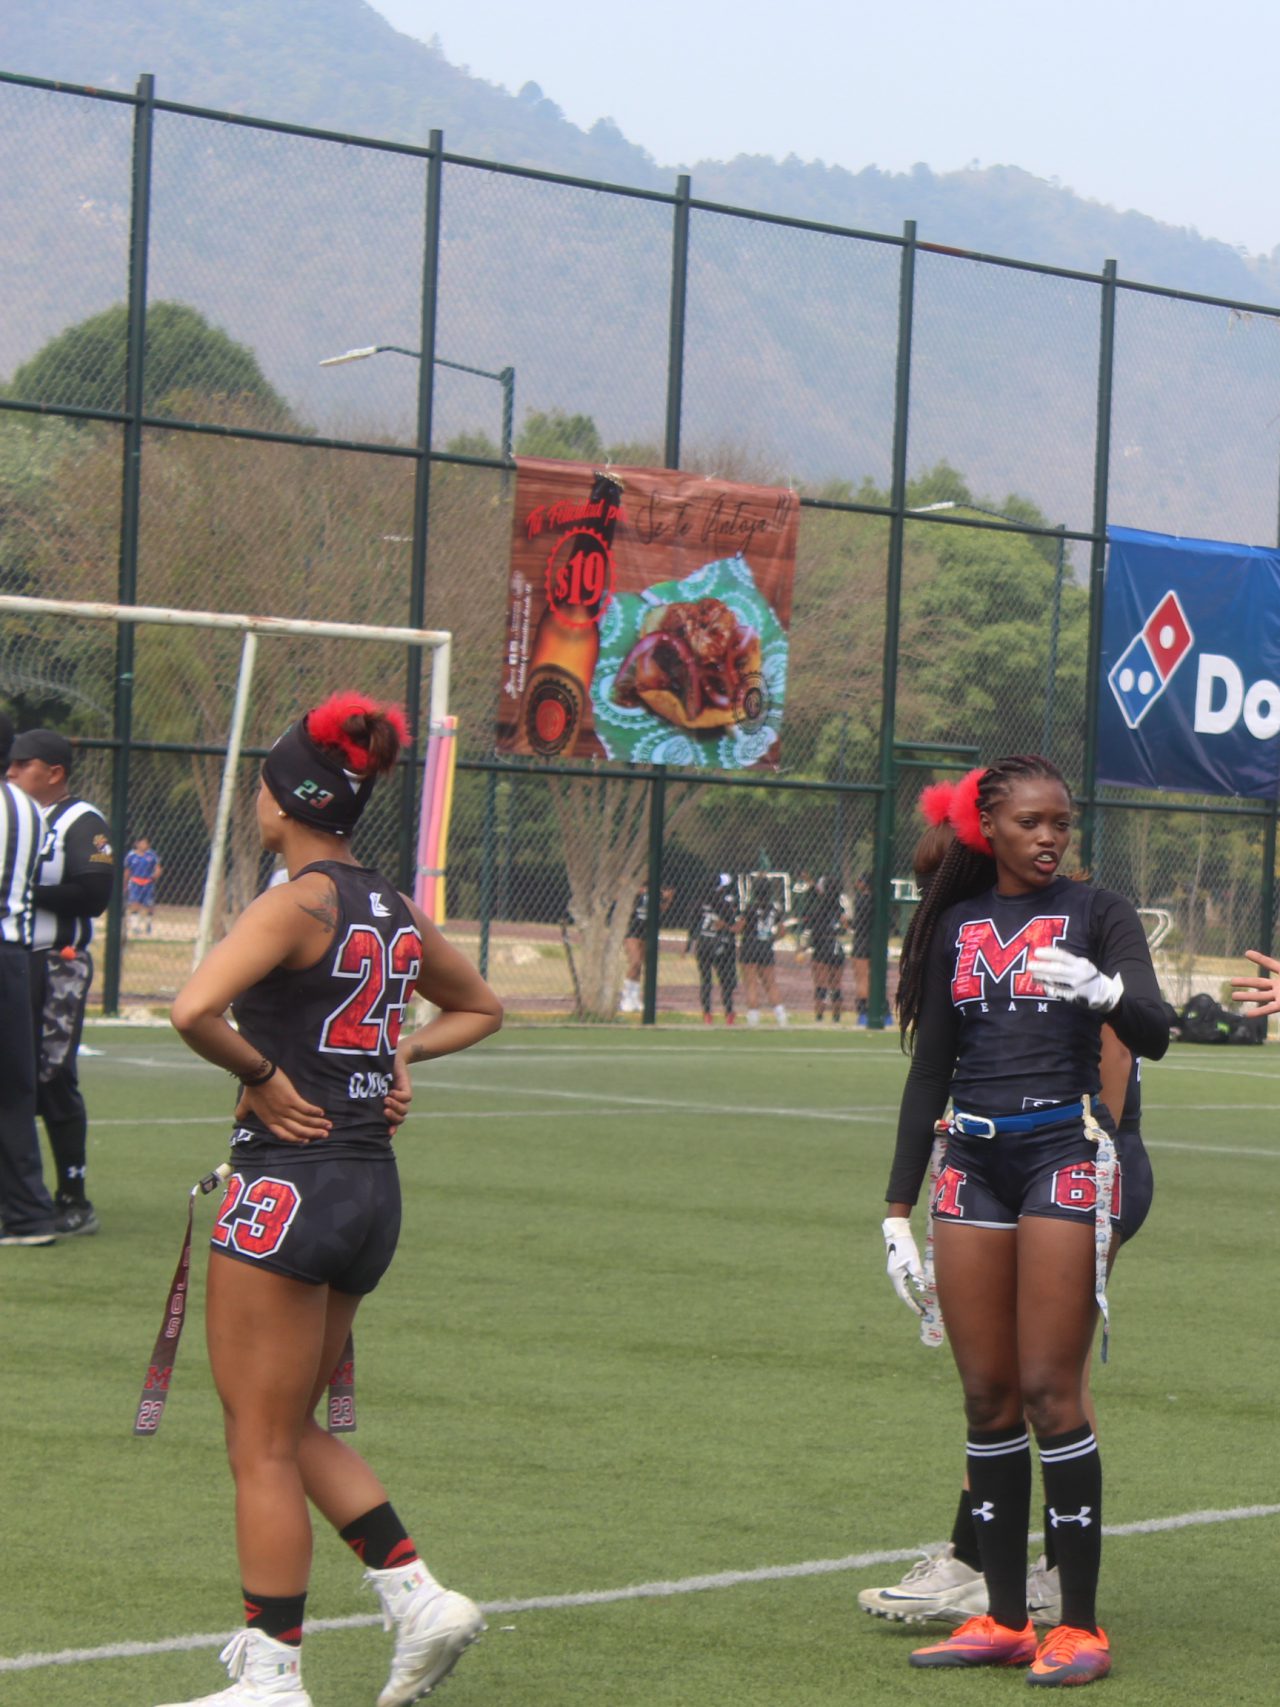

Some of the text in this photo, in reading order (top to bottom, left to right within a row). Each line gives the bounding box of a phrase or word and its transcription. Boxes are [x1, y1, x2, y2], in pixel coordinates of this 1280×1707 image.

[554, 549, 606, 607] $19
[293, 779, 335, 809] 23
[952, 915, 1069, 1008] M
[319, 923, 424, 1056] 23
[1016, 971, 1046, 993] FLA
[959, 1001, 1049, 1016] TEAM
[211, 1172, 302, 1259] 23
[144, 1365, 172, 1391] M
[136, 1400, 163, 1430] 23
[329, 1396, 353, 1426] 23
